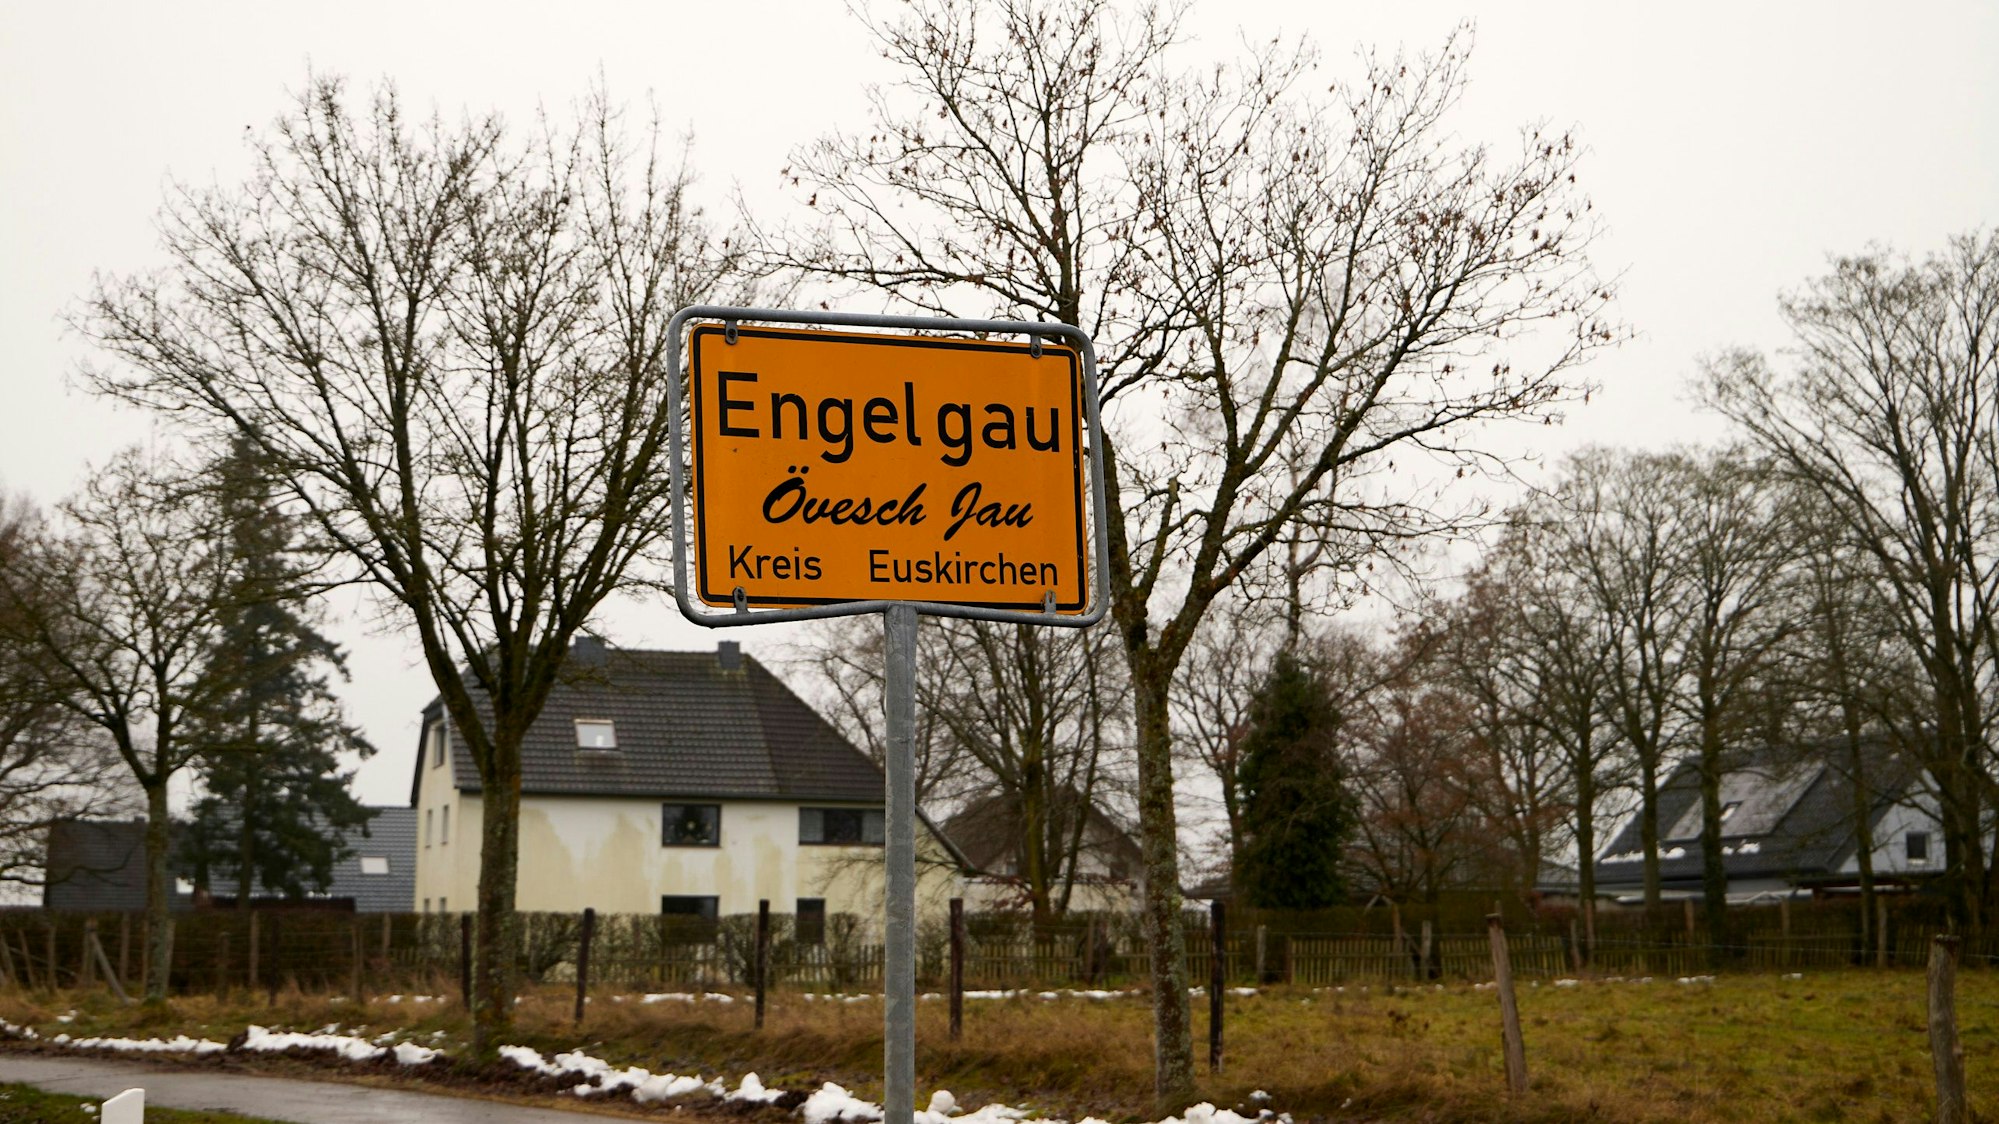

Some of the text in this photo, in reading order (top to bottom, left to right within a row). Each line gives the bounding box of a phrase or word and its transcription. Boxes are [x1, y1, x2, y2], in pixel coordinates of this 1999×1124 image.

[718, 371, 1060, 467] Engelgau
[762, 465, 1034, 541] Övesch Jau
[728, 545, 1059, 587] Kreis Euskirchen
